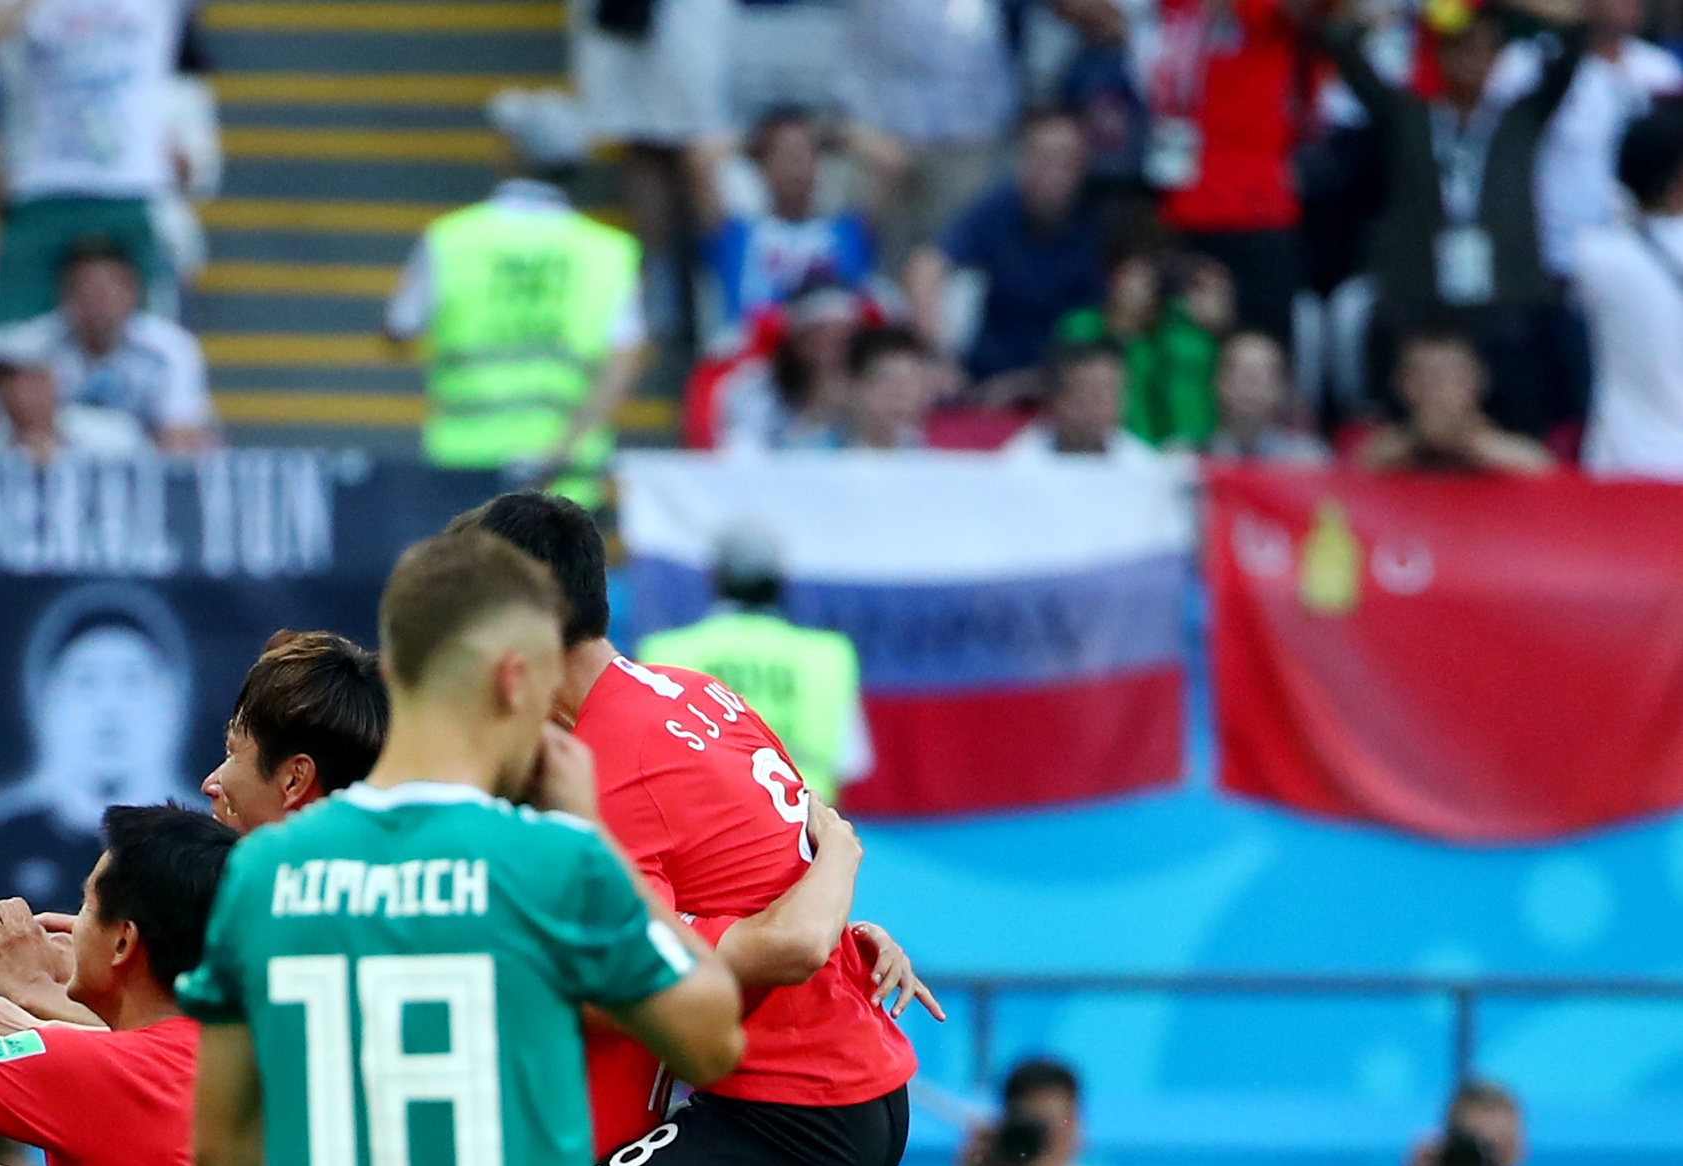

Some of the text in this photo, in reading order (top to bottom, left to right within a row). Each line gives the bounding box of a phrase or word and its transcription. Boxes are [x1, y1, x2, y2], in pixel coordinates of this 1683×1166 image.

[665, 720, 706, 751] S
[686, 703, 721, 739] J
[271, 858, 489, 918] KIMMICH
